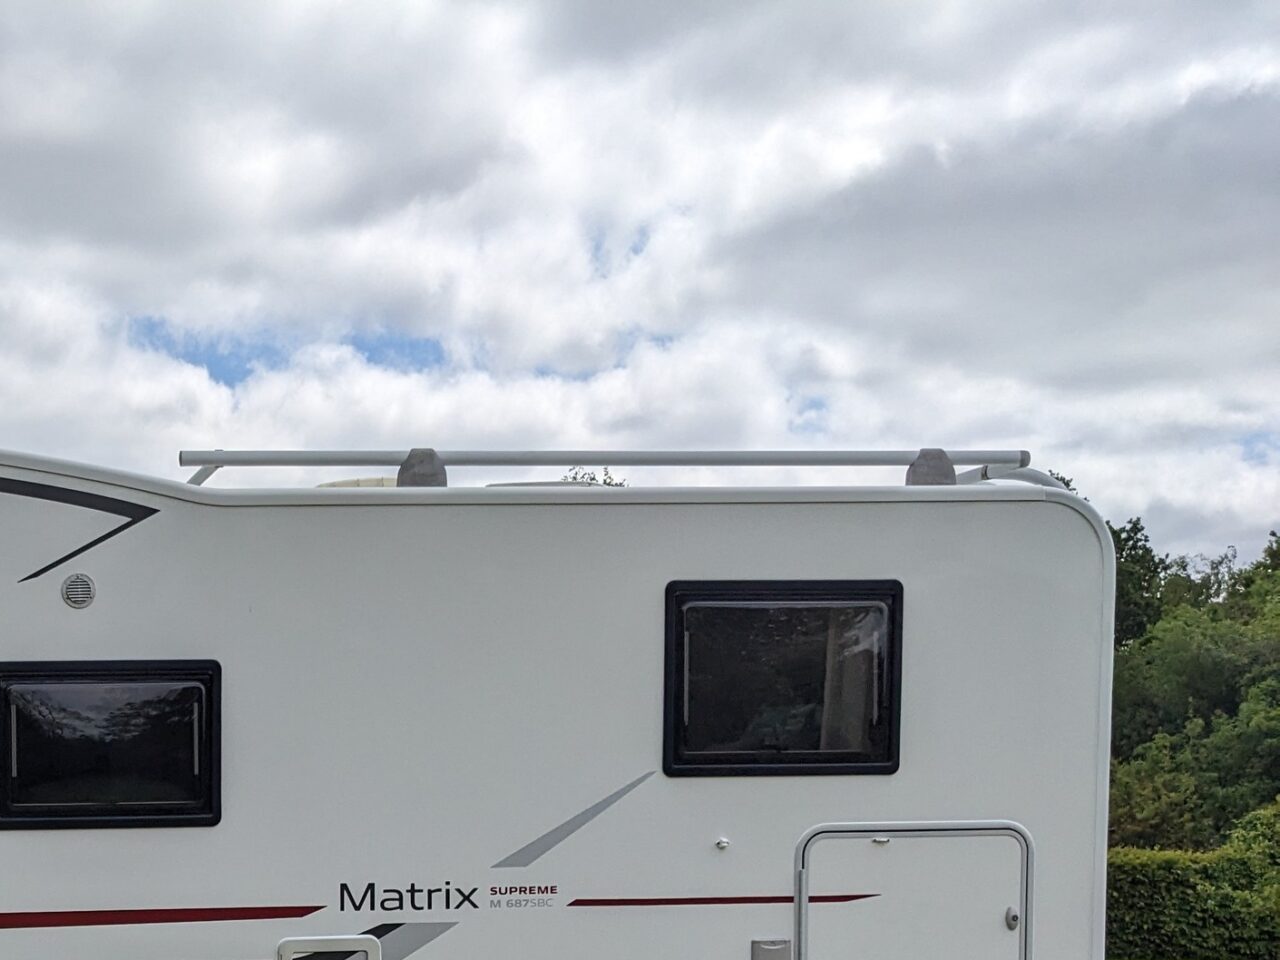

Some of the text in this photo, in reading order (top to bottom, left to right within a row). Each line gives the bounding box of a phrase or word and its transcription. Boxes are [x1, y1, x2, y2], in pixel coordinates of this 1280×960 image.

[339, 881, 479, 911] Matrix
[489, 886, 558, 896] SUPREME
[489, 898, 553, 909] M 687SBC
